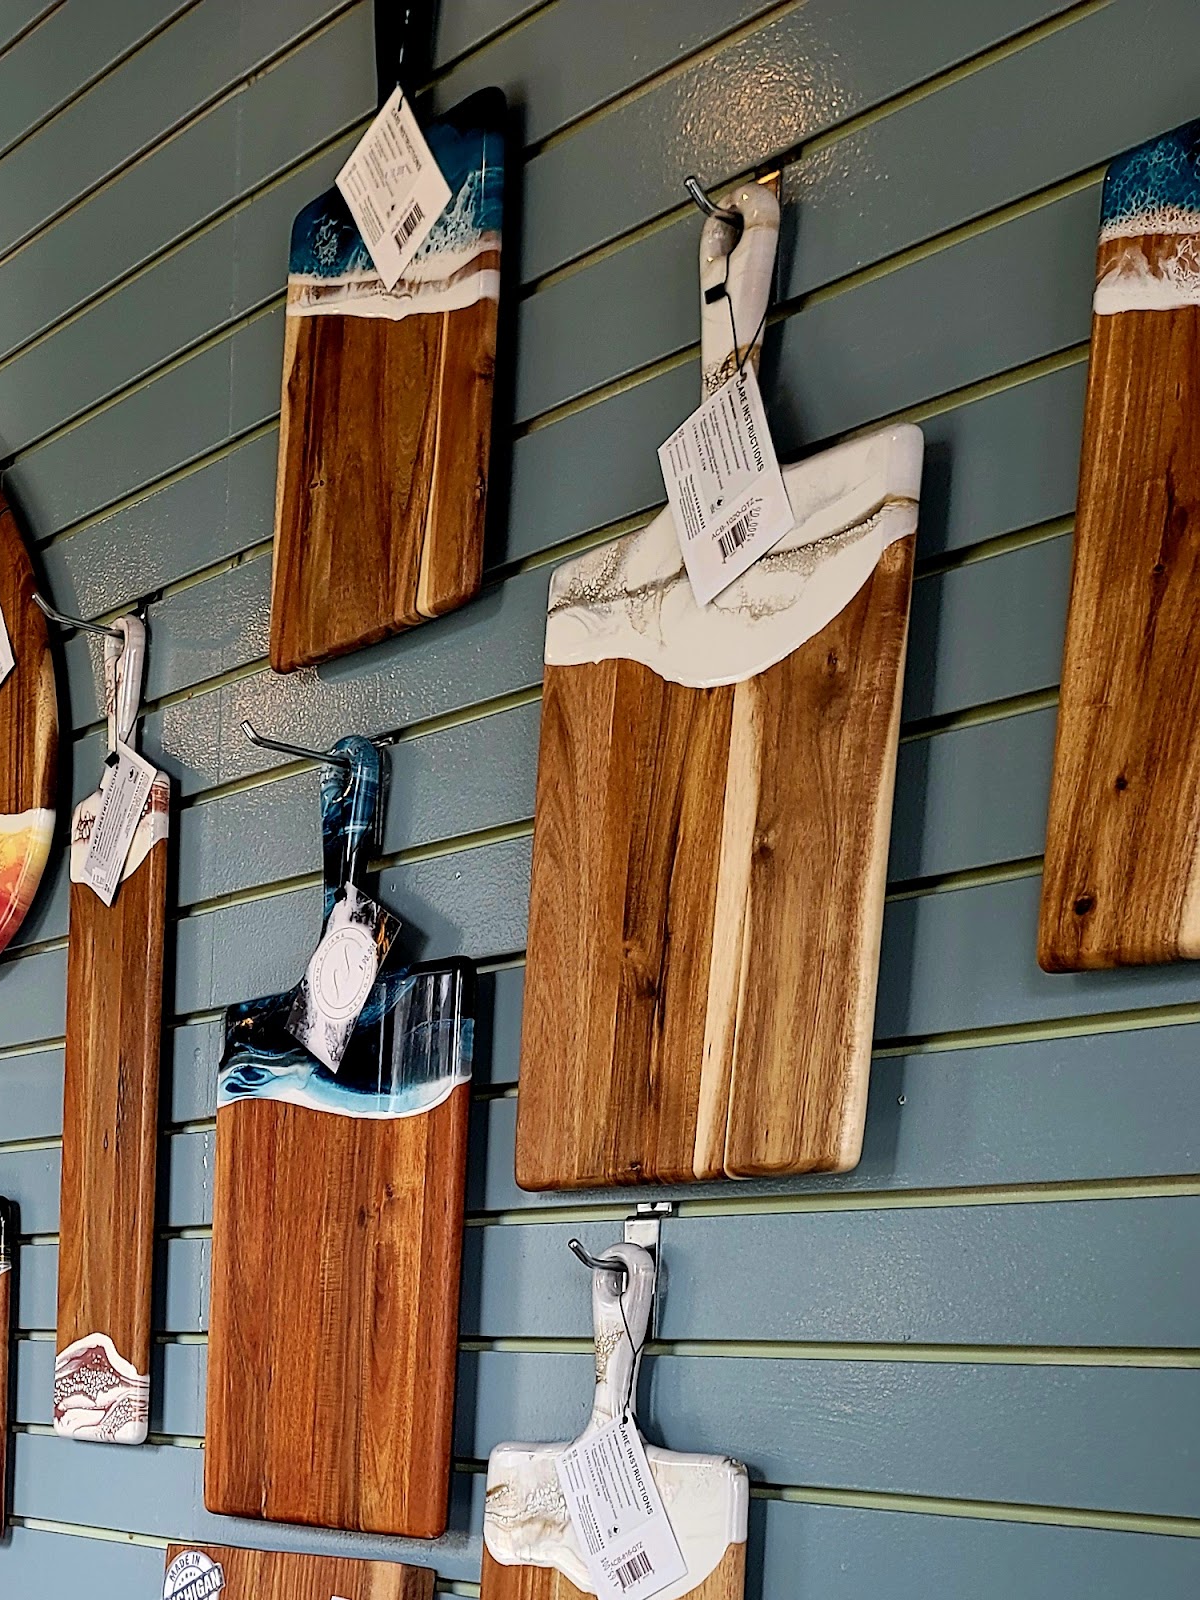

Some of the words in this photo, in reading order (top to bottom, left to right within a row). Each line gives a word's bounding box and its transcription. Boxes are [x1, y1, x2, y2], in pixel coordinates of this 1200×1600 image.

[735, 380, 747, 405] CARE
[739, 404, 765, 472] INSTRUCTIONS
[618, 1423, 630, 1449] CARE
[626, 1448, 654, 1516] INSTRUCTIONS
[169, 1554, 190, 1582] MADE
[191, 1554, 201, 1566] IN
